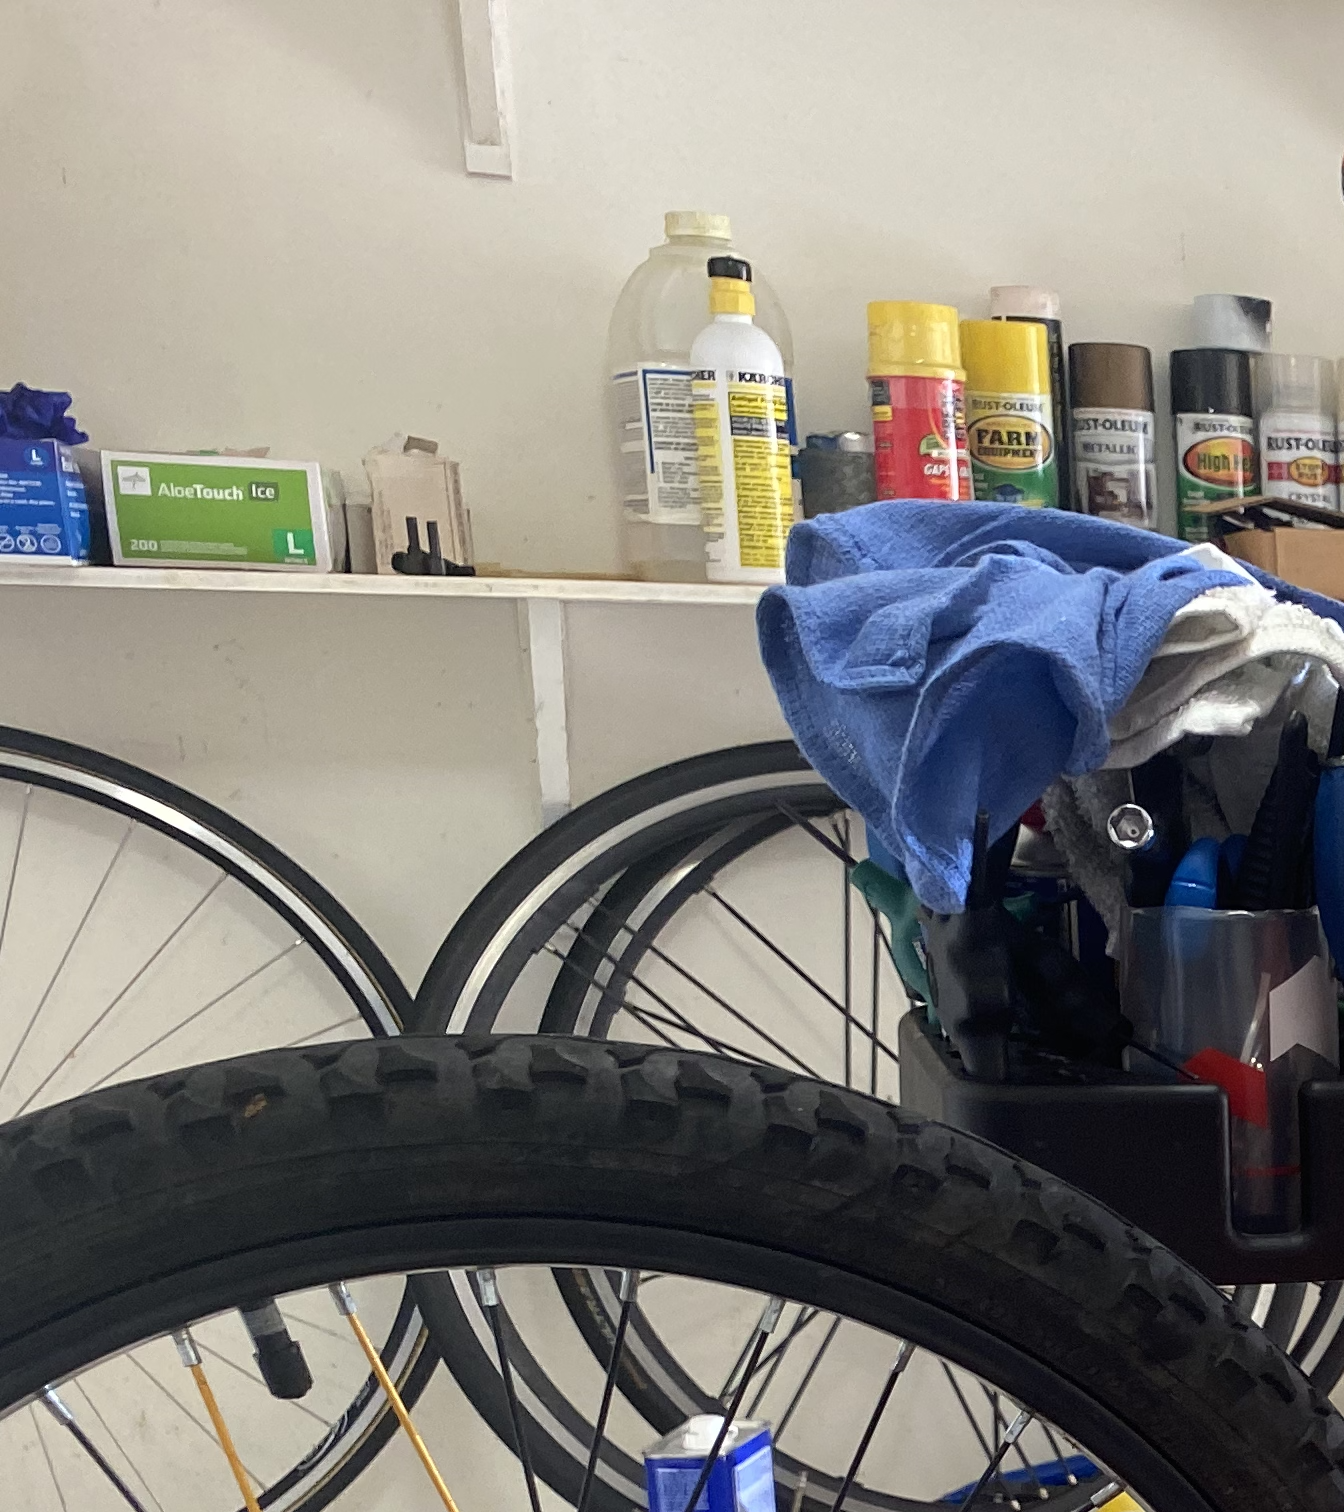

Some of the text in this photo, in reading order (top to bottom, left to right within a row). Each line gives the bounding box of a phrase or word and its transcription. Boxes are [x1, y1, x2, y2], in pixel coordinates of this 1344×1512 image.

[158, 482, 275, 501] AloeTouch Ice
[130, 539, 158, 551] 200
[287, 532, 305, 555] L
